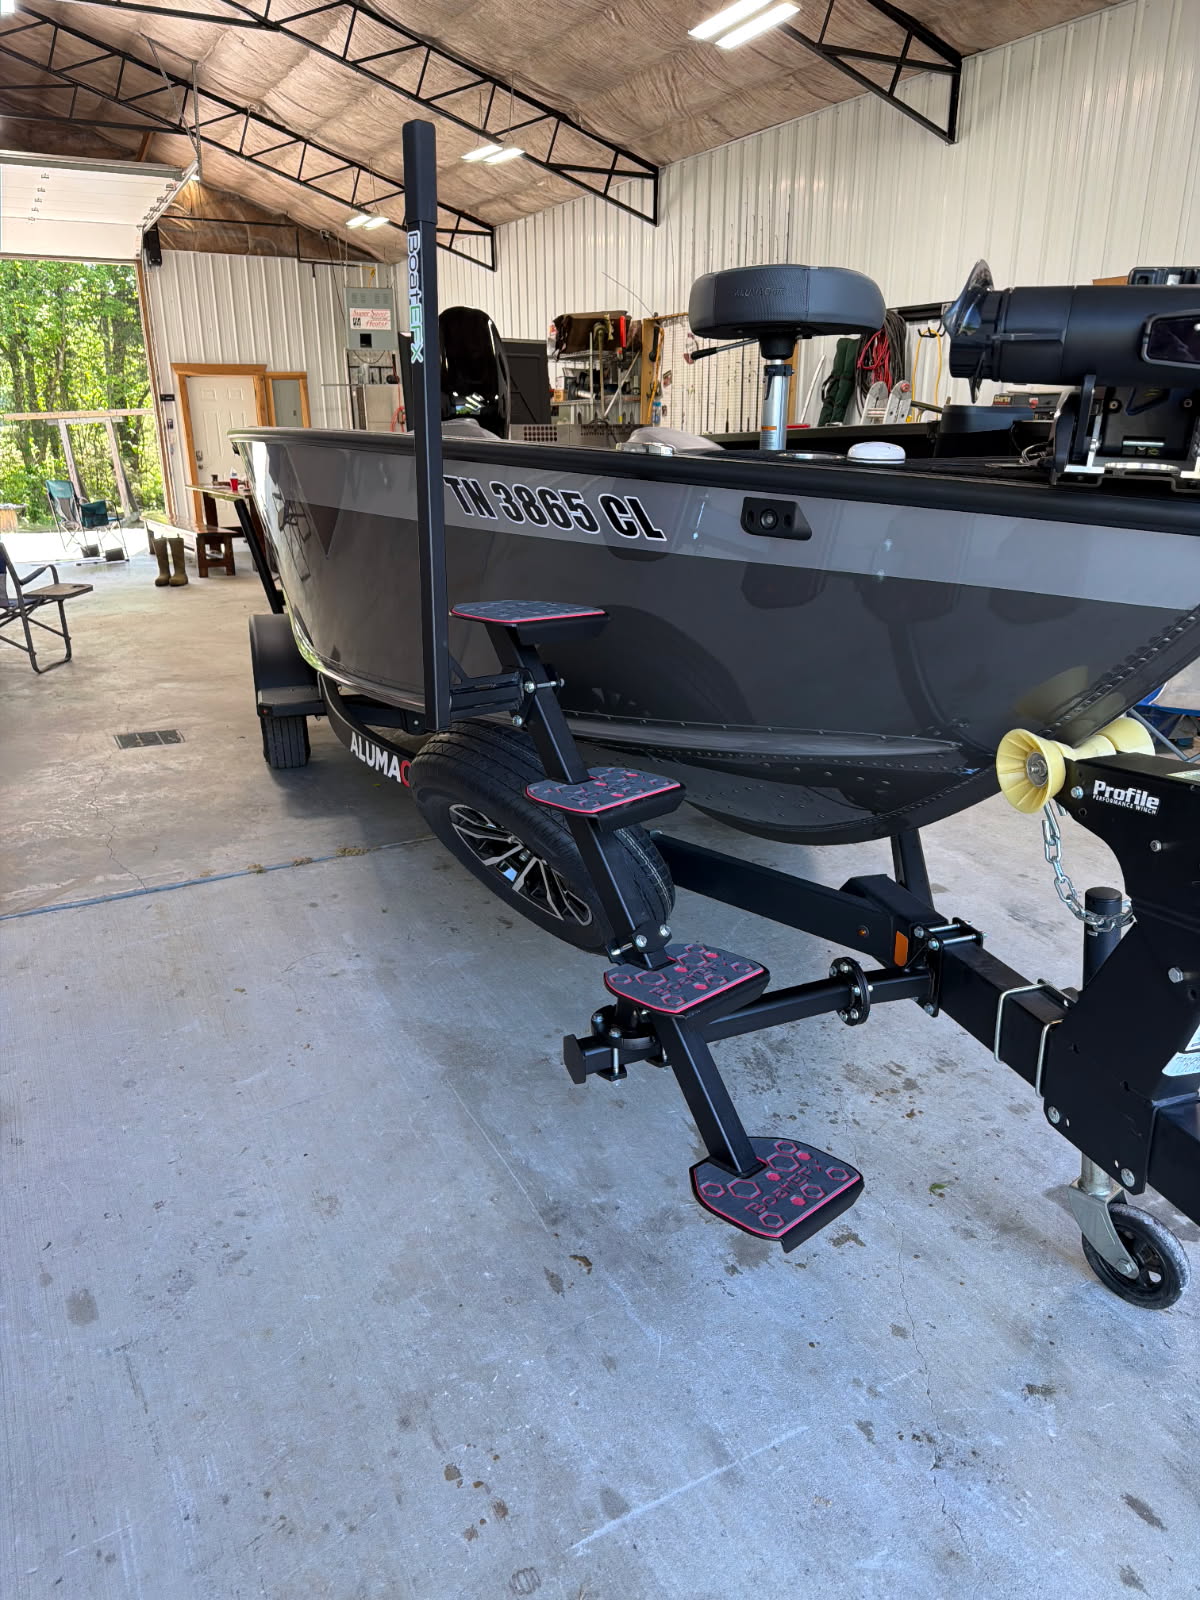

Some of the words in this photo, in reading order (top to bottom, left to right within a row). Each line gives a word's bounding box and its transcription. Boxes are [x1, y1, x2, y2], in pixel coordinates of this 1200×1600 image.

[408, 230, 423, 363] BoatEFX
[443, 475, 498, 519] TN
[490, 481, 600, 534] 3865
[598, 494, 667, 541] CL
[1092, 794, 1133, 809] PERFORMANCE
[1135, 805, 1157, 815] WINCH
[1093, 779, 1160, 810] Profile
[744, 1159, 823, 1216] BoatEFX
